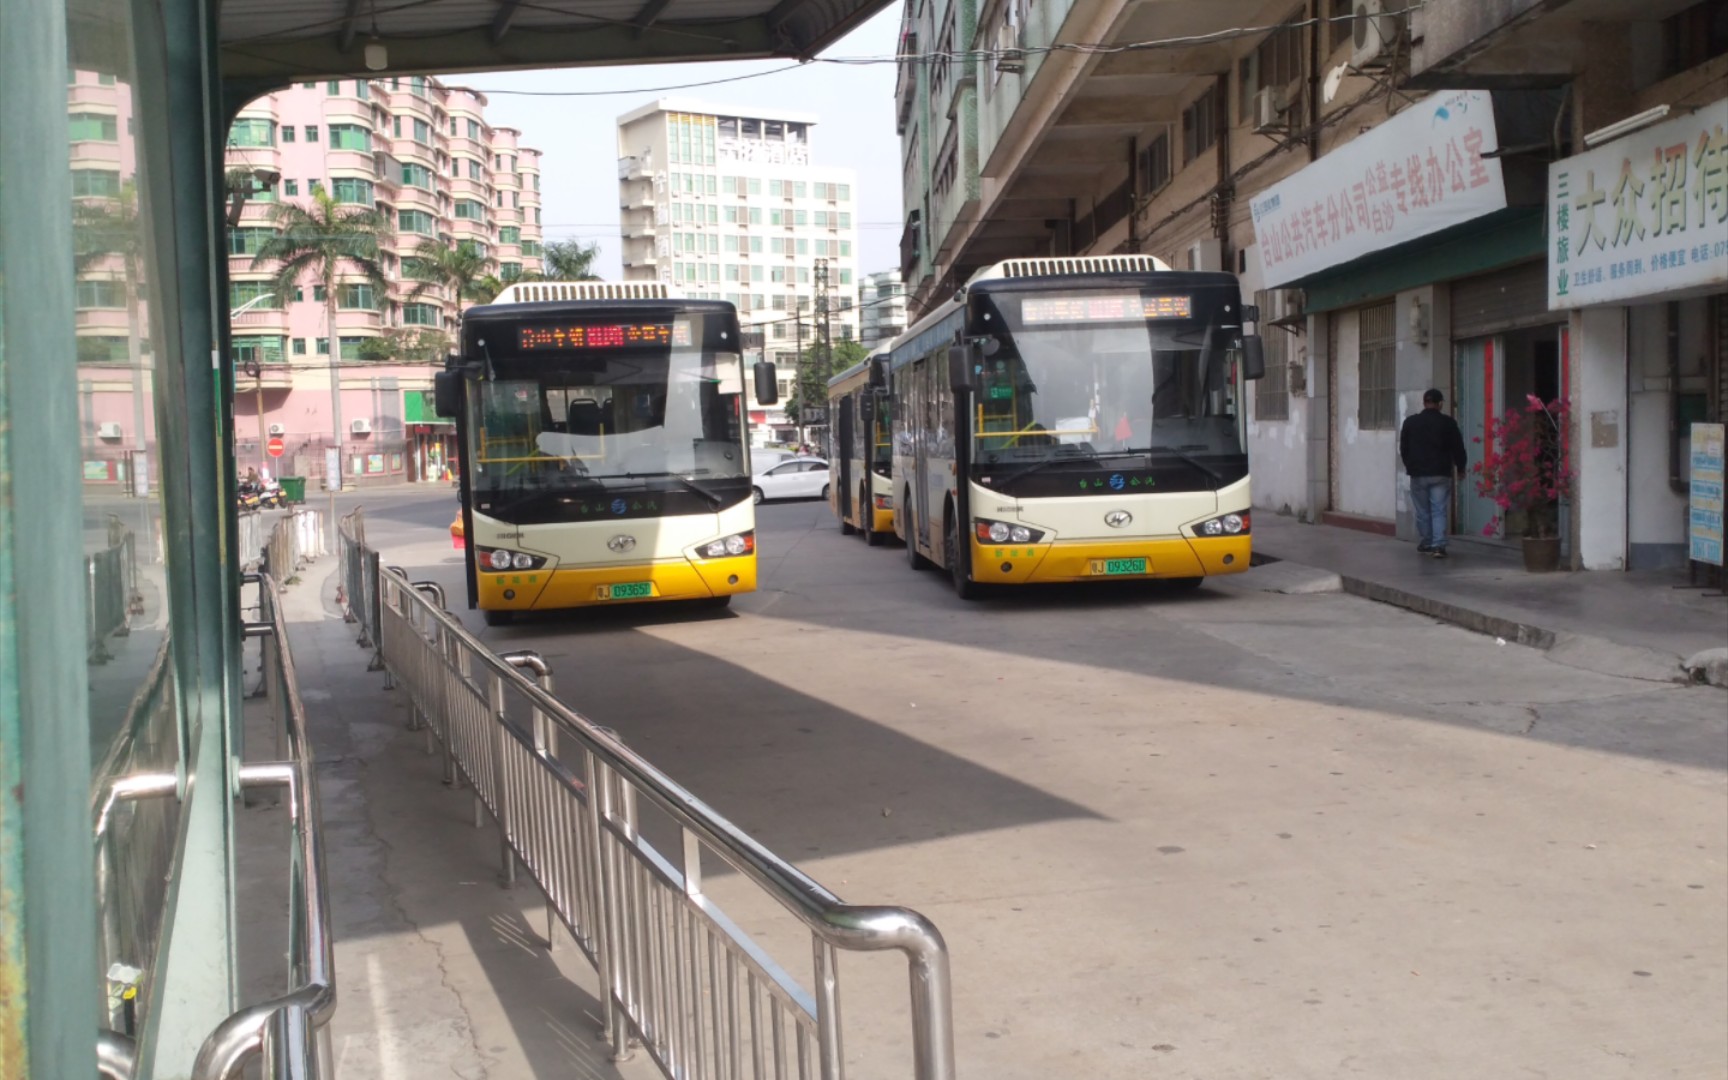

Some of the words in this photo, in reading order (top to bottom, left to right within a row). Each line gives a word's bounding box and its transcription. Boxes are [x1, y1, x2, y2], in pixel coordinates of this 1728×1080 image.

[1390, 126, 1489, 216] 专线办公室
[1575, 124, 1728, 257] 大众招待
